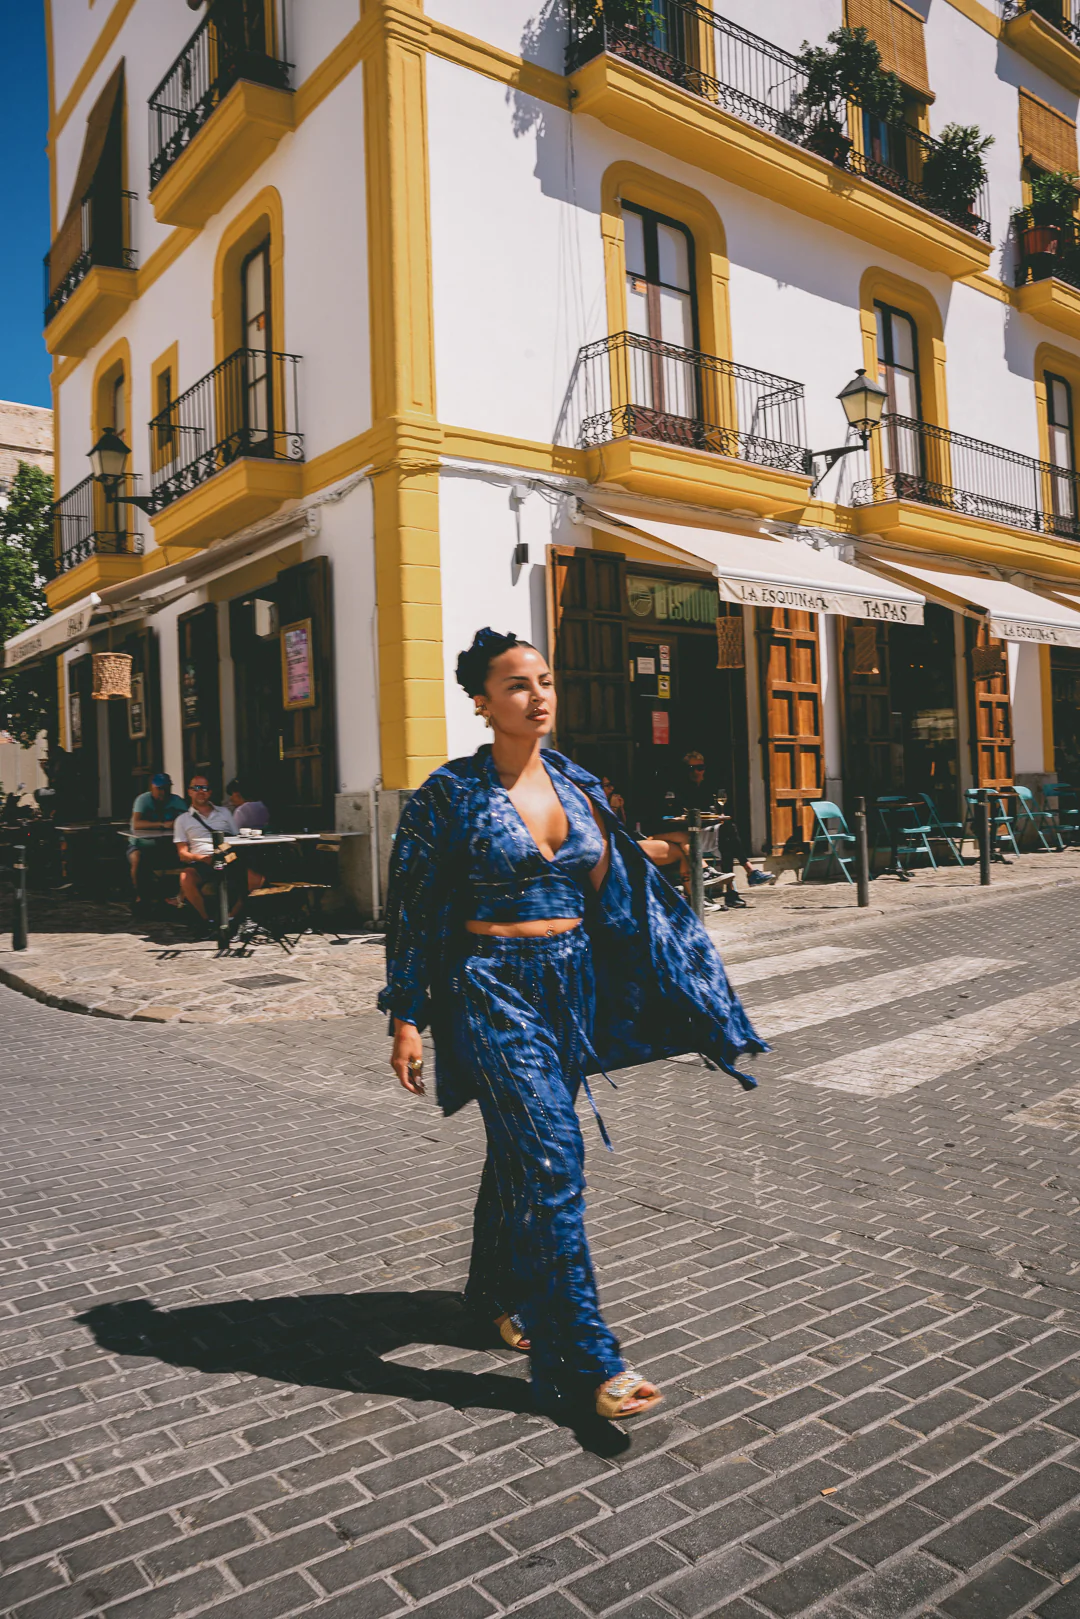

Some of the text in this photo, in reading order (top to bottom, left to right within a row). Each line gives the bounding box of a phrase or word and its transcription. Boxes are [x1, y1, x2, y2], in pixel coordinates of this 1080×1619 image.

[741, 585, 817, 610] LA ESQUINA
[863, 600, 908, 622] TAPAS
